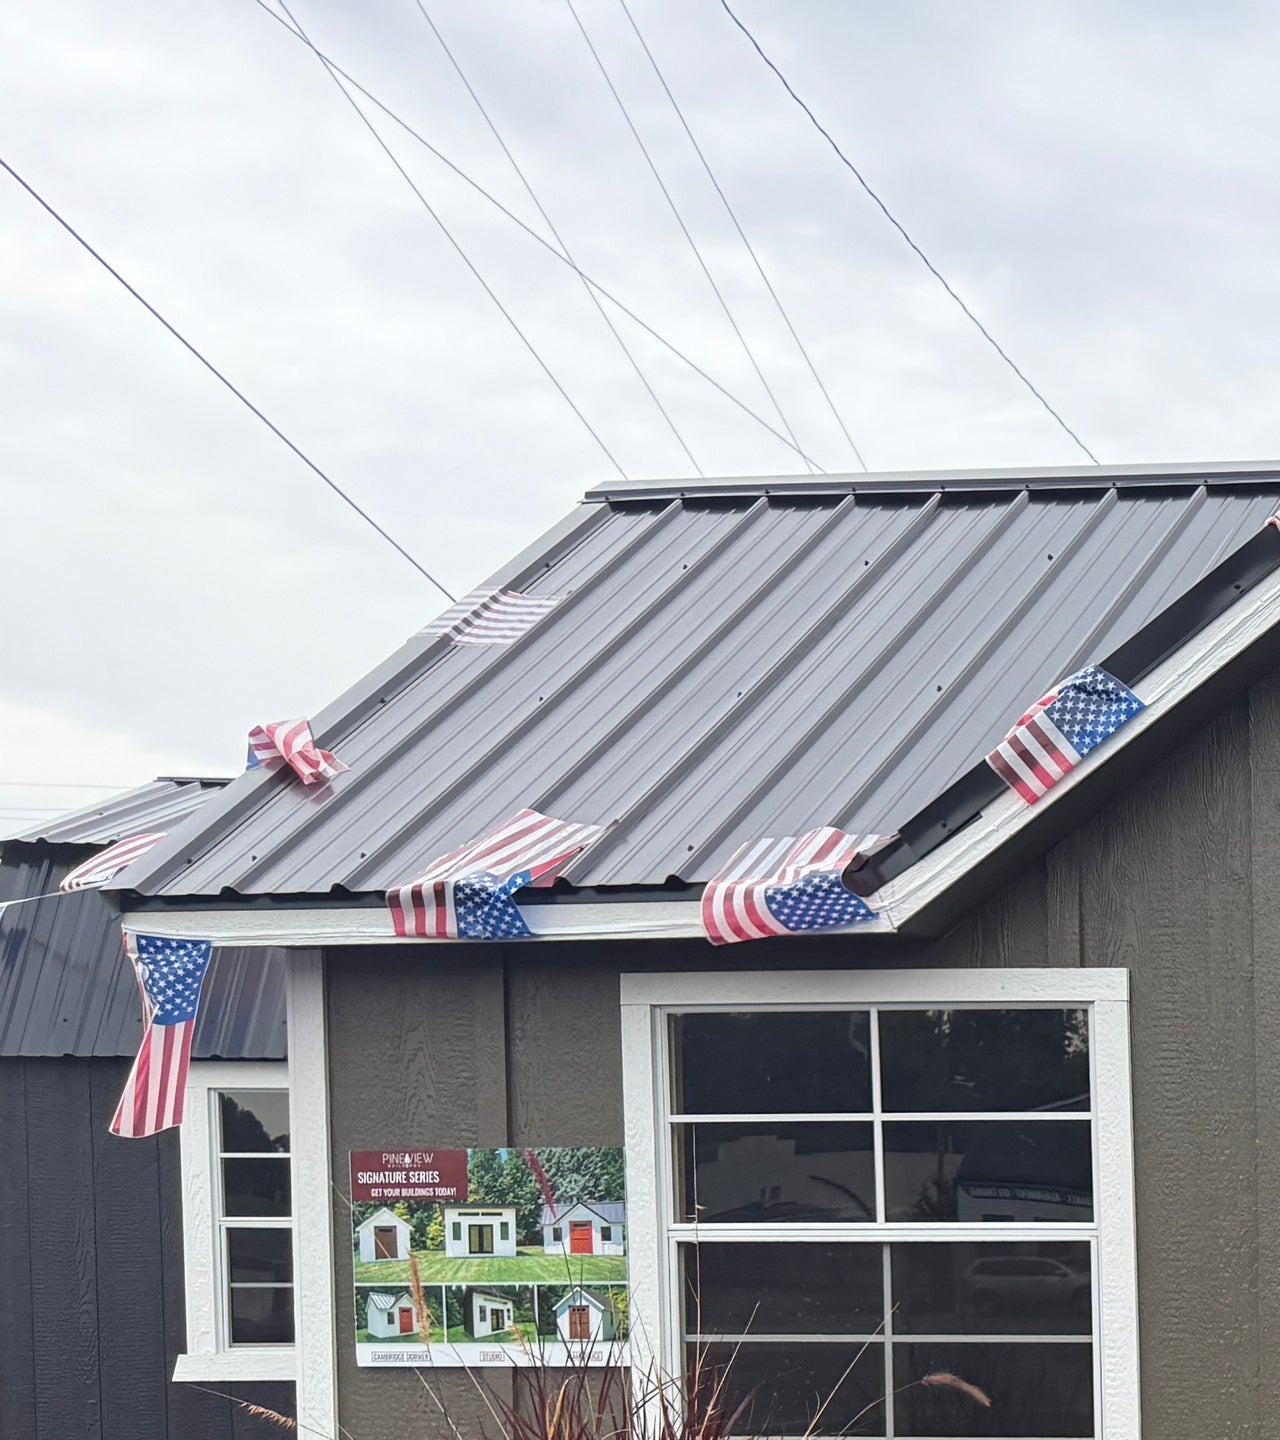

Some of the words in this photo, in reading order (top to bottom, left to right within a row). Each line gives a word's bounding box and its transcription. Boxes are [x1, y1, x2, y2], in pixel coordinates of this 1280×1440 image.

[382, 1153, 434, 1164] PINEVIEW
[357, 1171, 407, 1184] SIGNATURE
[409, 1171, 440, 1183] SERIES
[371, 1188, 382, 1197] GET
[383, 1188, 400, 1197] YOUR
[401, 1188, 434, 1197] BUILDINGS
[435, 1187, 457, 1196] TODAY!
